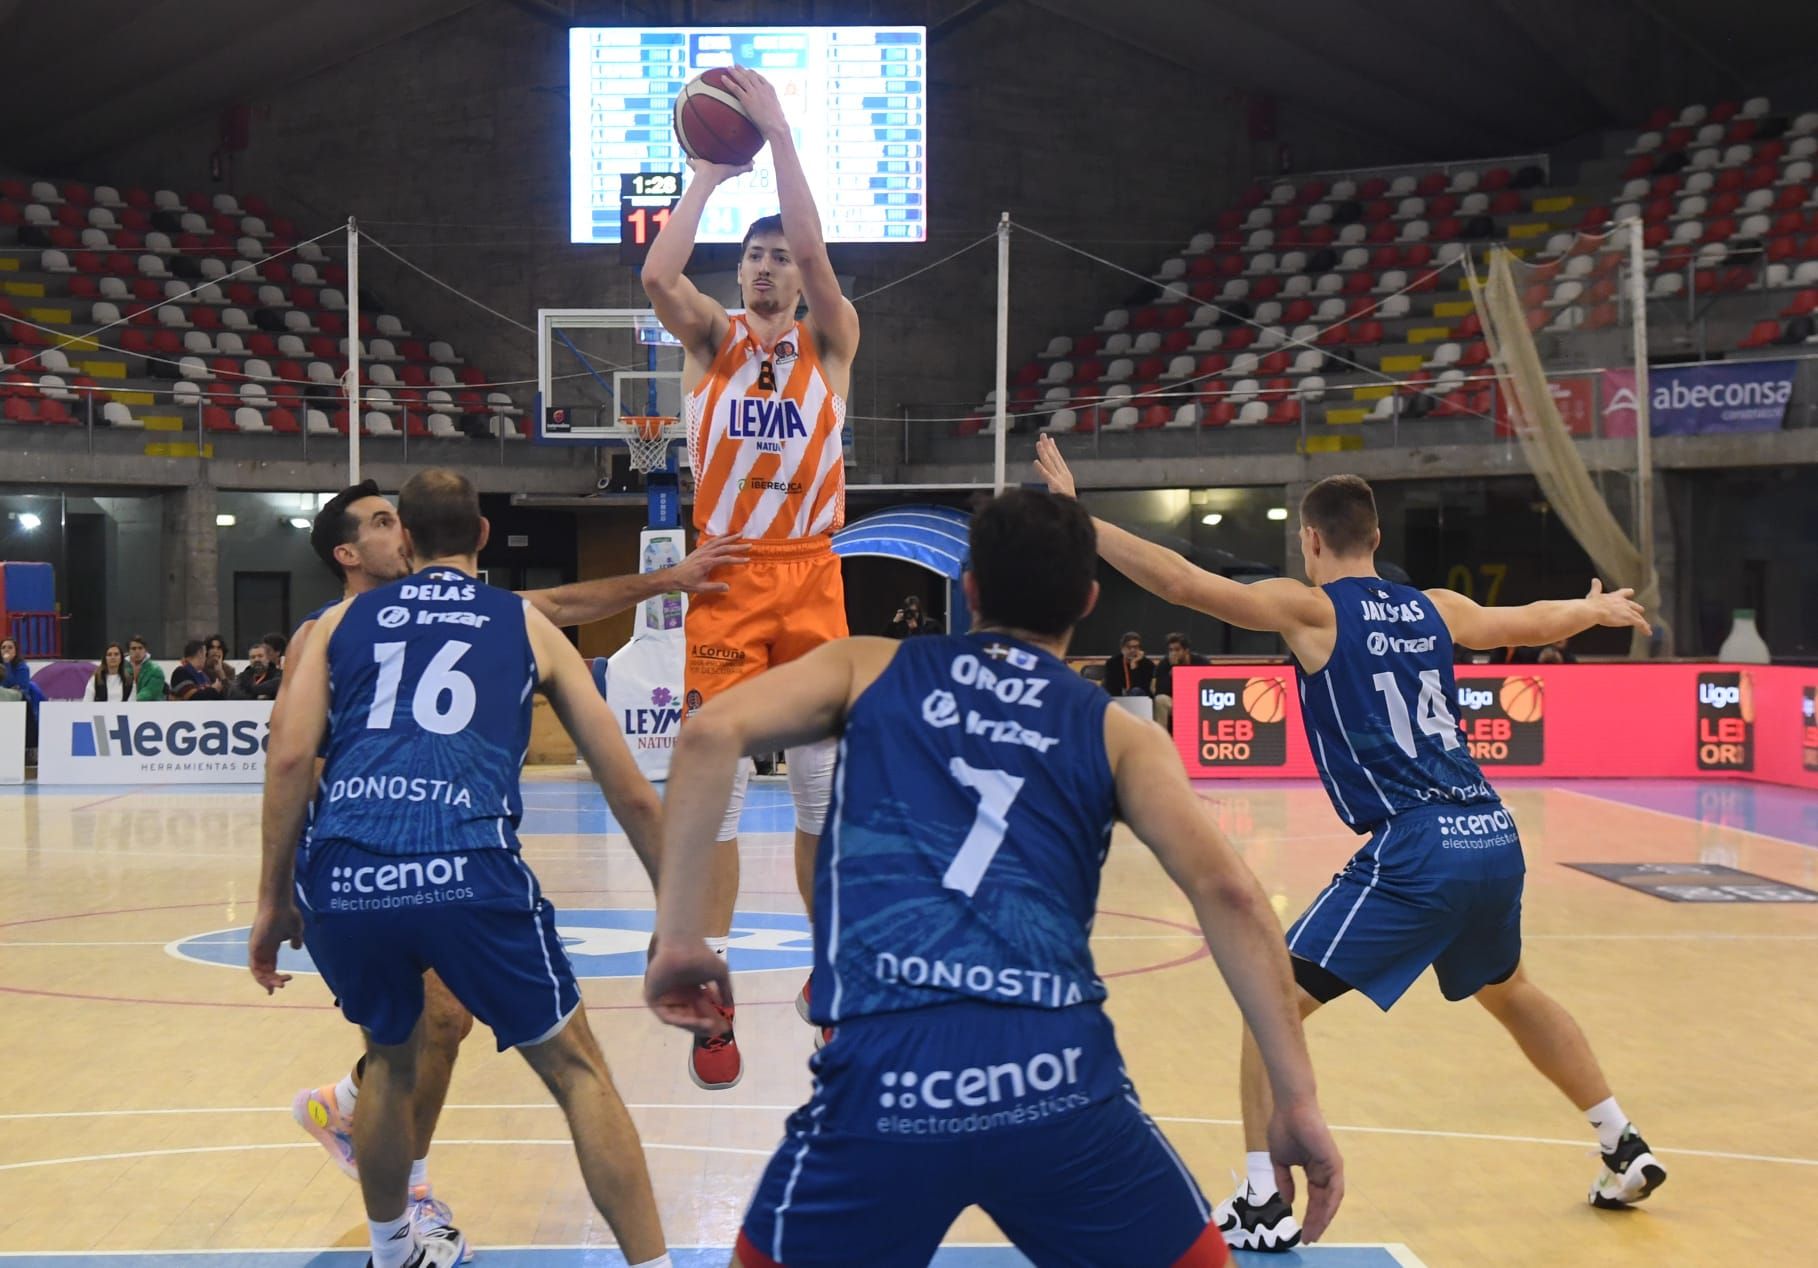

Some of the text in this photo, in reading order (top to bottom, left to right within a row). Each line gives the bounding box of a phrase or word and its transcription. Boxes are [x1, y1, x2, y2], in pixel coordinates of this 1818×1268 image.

[1653, 379, 1792, 410] abeconsa
[756, 441, 781, 452] NATU
[400, 584, 476, 601] DELAŠ
[366, 639, 477, 735] 16
[951, 654, 1050, 708] OROZ
[1700, 683, 1739, 708] Liga
[1202, 689, 1235, 710] Liga
[1373, 669, 1461, 758] 14
[1458, 688, 1493, 709] Liga
[1203, 720, 1254, 741] LEB
[141, 762, 257, 771] HERRAMIENTAS DE
[1202, 743, 1250, 760] ORO
[330, 776, 472, 808] DONOSTIA
[942, 757, 1025, 897] 7
[353, 856, 468, 893] cenor
[331, 886, 474, 910] electrodomésticos
[875, 952, 1083, 1008] DONOSTIA
[921, 1047, 1082, 1109] cenor
[877, 1091, 1090, 1134] electrodomésticos
